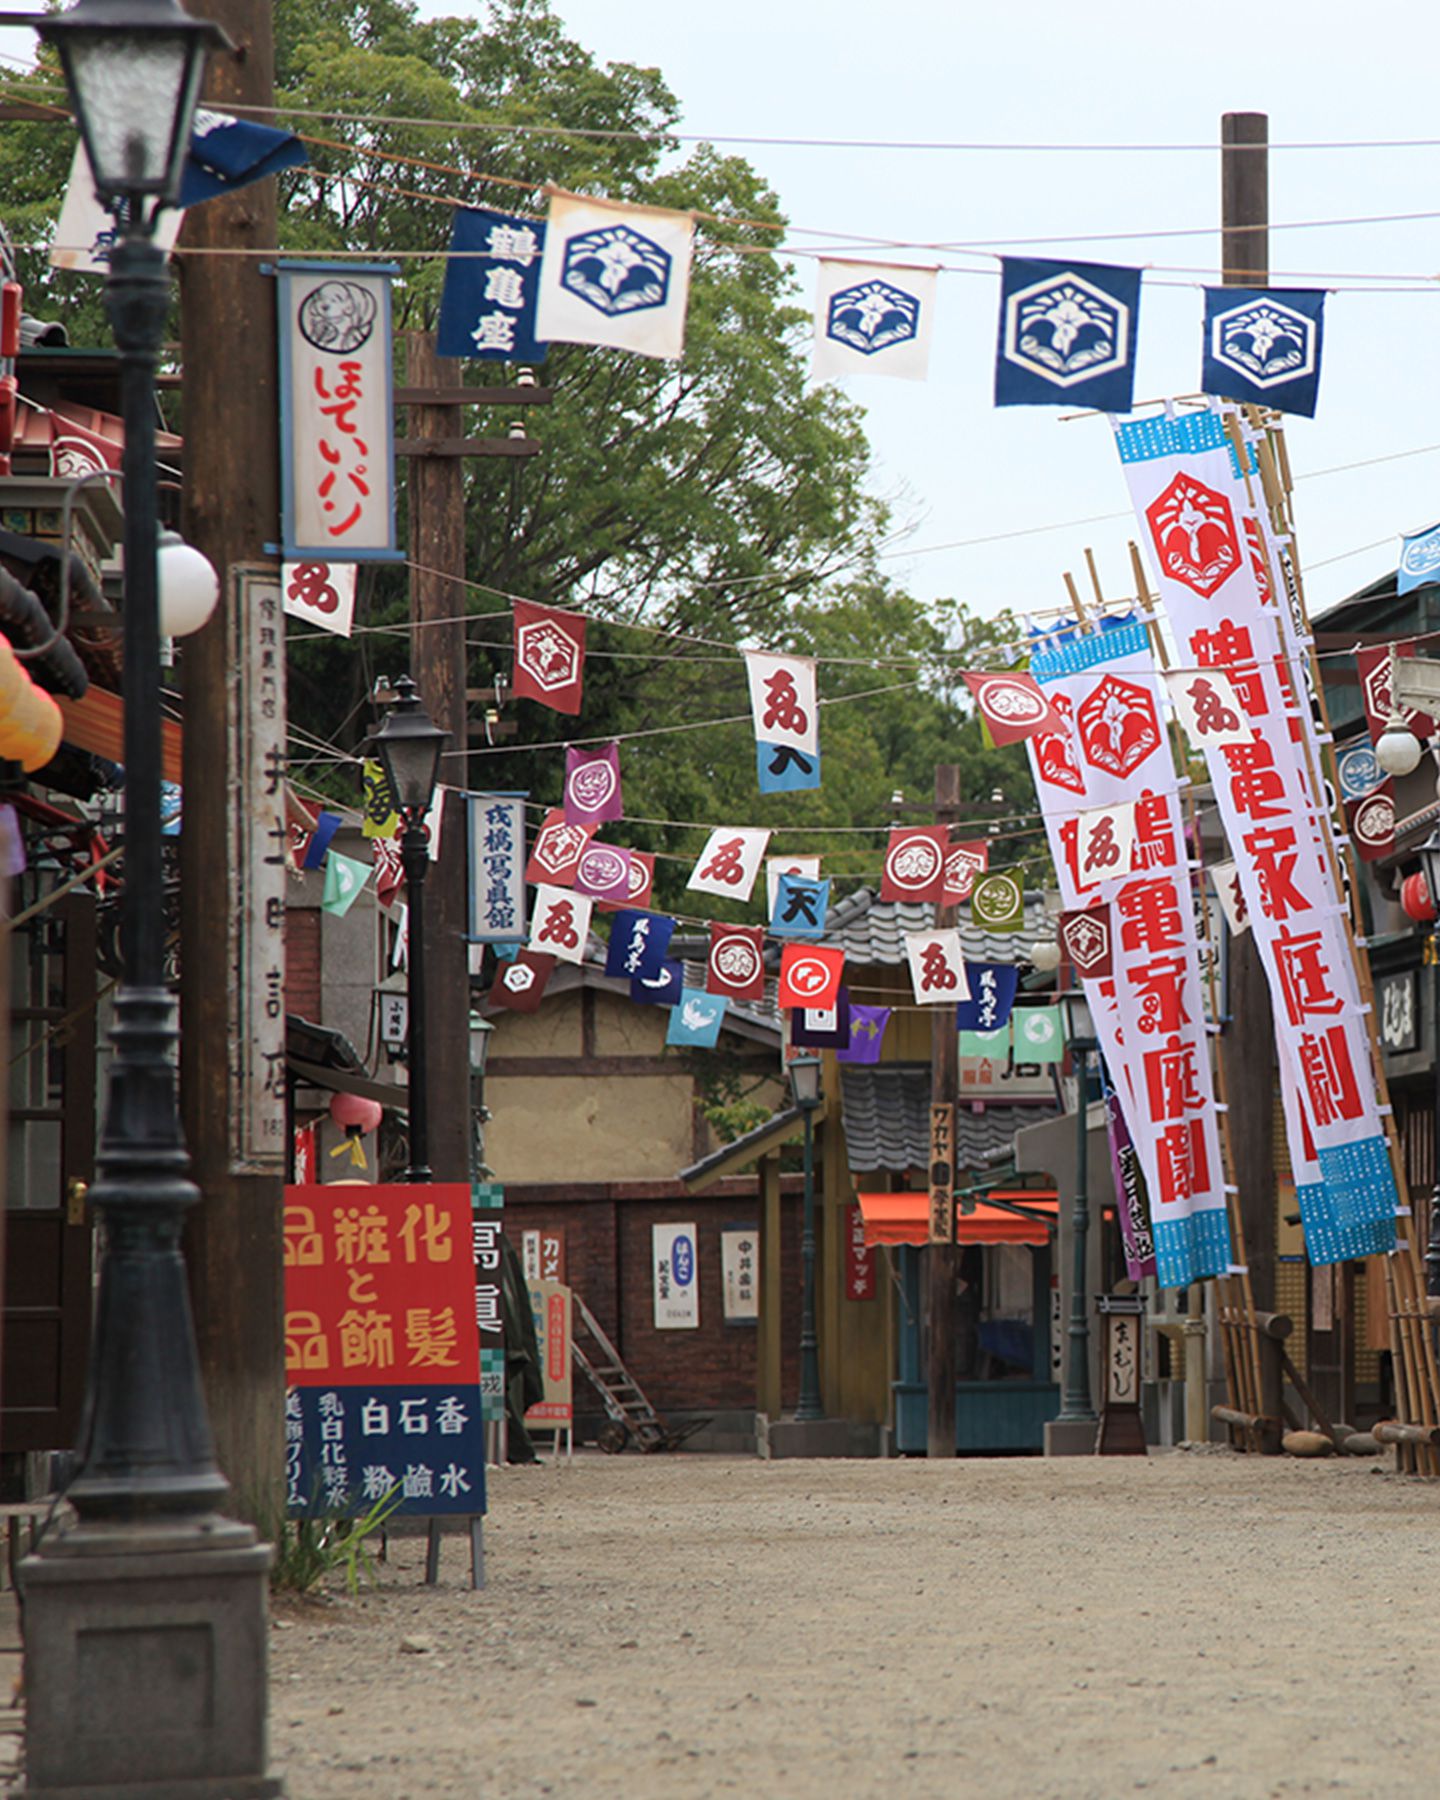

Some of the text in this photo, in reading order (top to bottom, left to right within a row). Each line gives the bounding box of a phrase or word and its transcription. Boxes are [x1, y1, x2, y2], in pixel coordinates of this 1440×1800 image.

[471, 225, 538, 353] 鶴亀座
[314, 362, 369, 536] ほていパン
[781, 887, 820, 926] 天
[283, 1204, 453, 1266] 化粧品
[347, 1268, 378, 1303] と
[284, 1307, 461, 1369] 髪飾品
